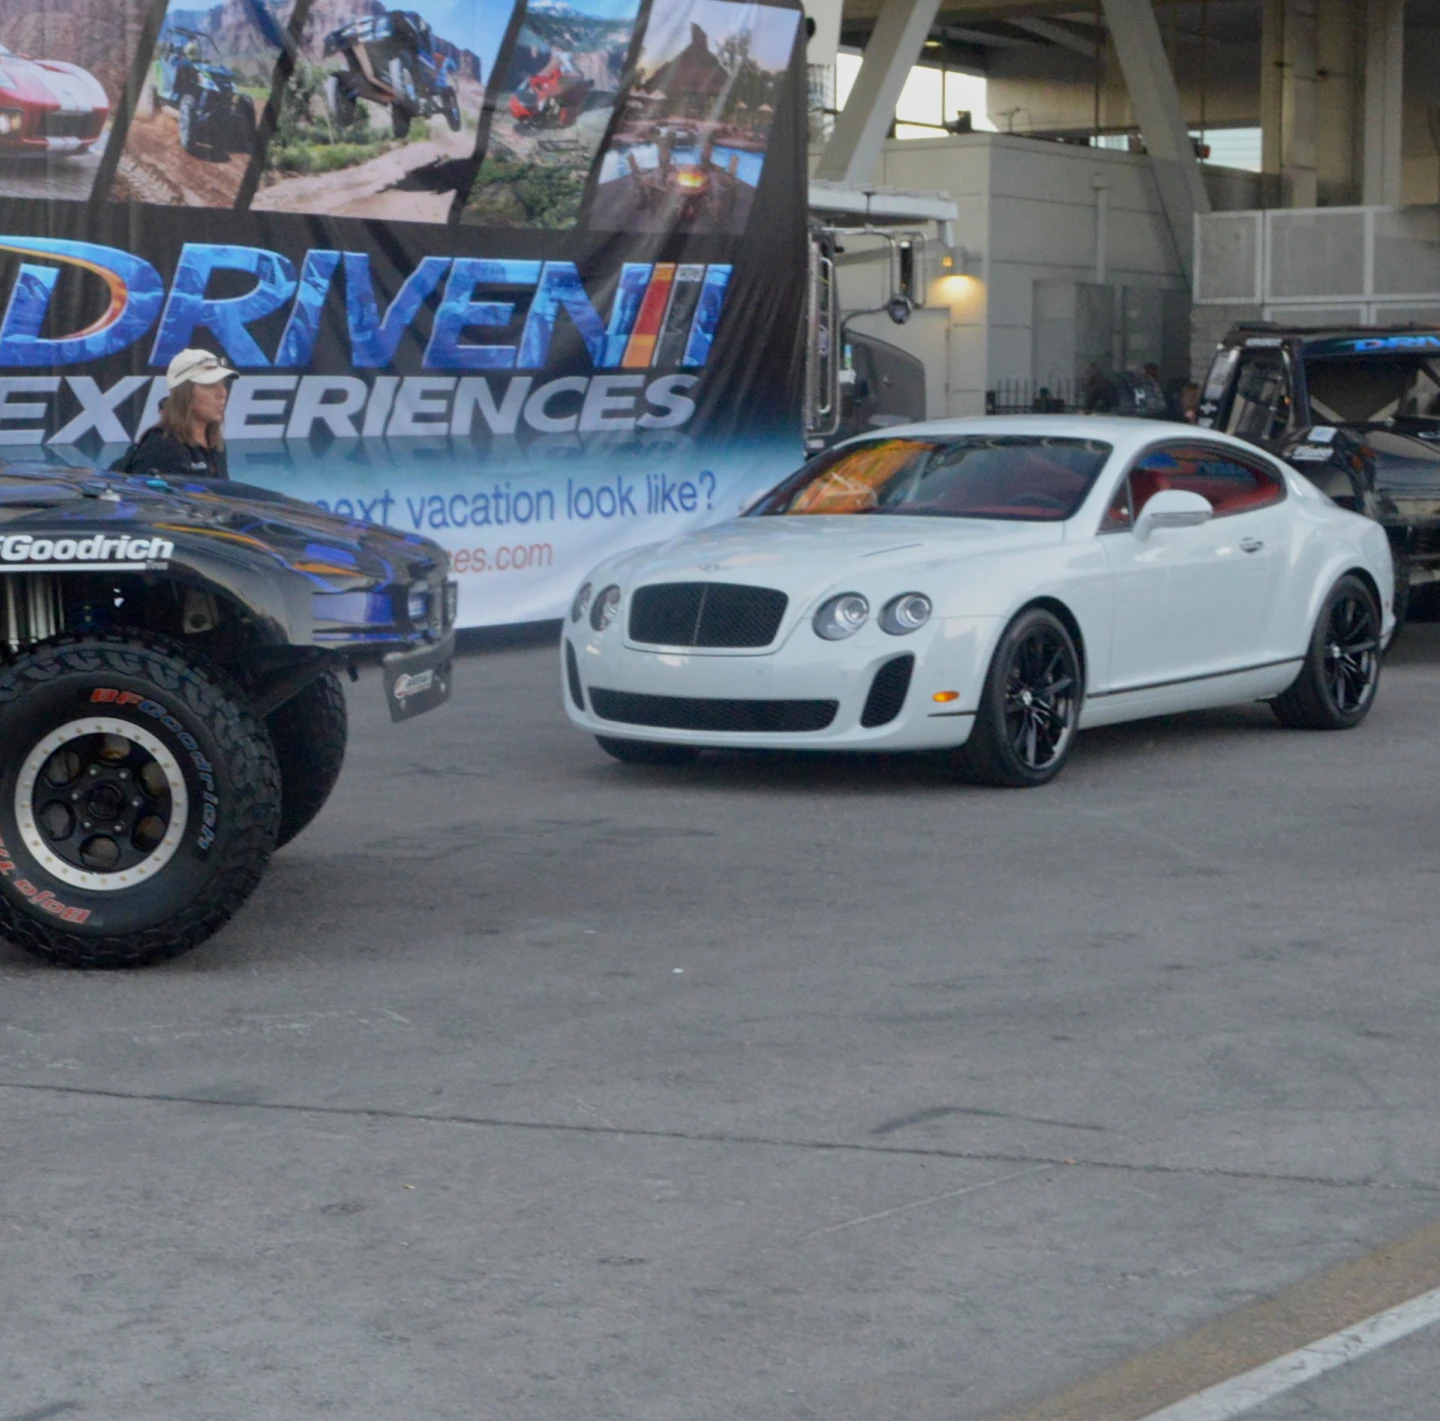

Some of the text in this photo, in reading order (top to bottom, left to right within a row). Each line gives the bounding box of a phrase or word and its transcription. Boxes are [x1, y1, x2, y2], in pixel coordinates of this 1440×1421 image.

[407, 480, 555, 530] vacation
[565, 476, 638, 520] look
[645, 470, 718, 515] like?
